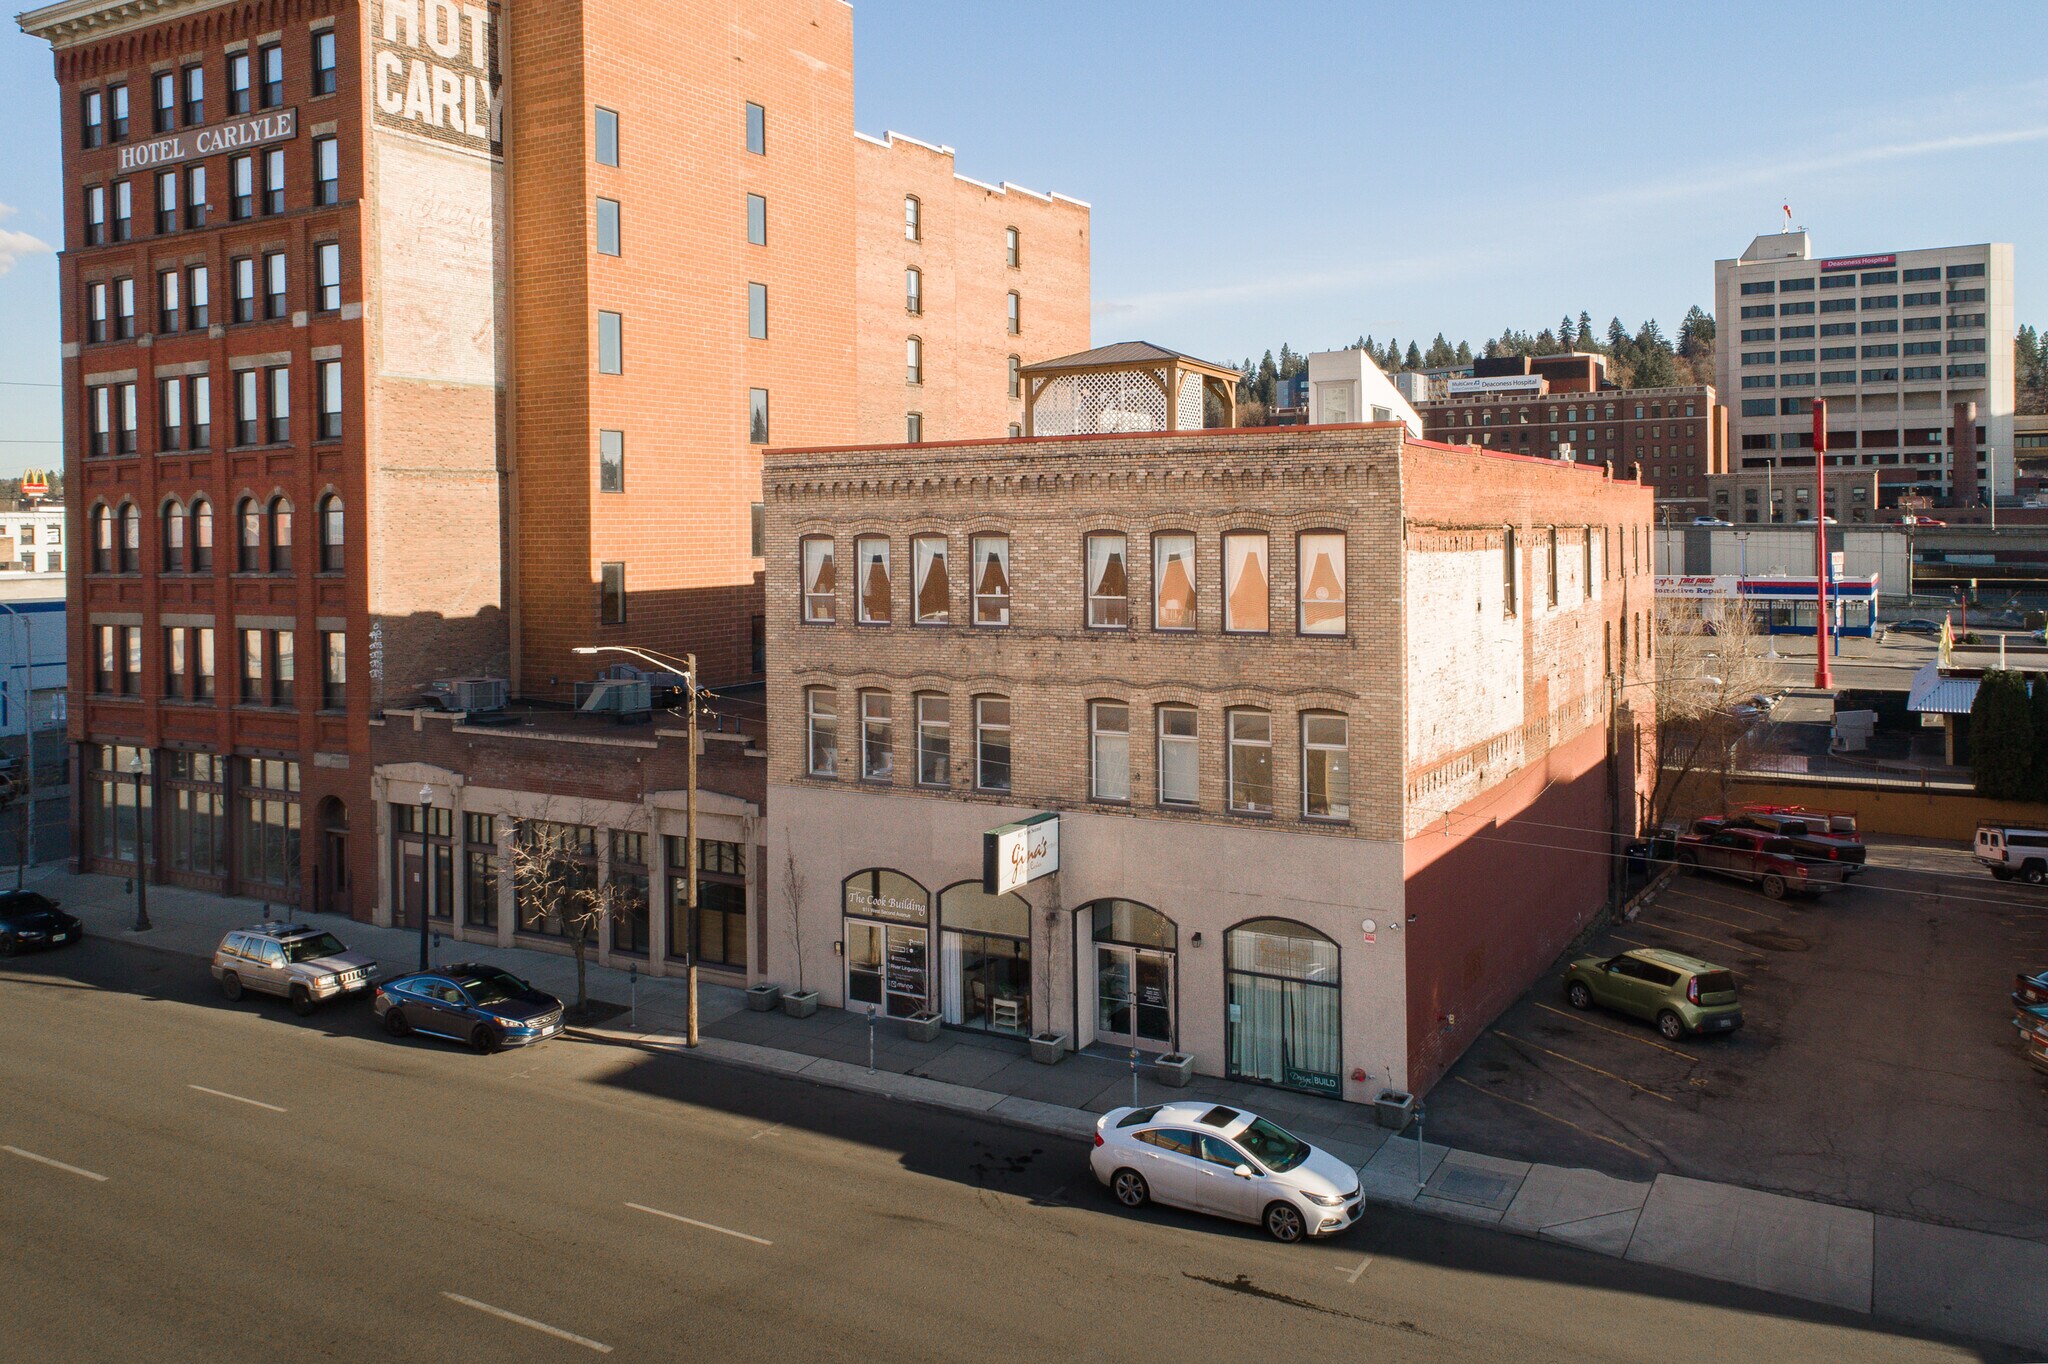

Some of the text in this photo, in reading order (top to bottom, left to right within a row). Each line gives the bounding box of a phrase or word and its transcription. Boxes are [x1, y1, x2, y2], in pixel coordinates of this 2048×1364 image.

[382, 0, 492, 69] HOT
[121, 113, 291, 169] HOTEL CARLYLE
[1828, 256, 1889, 267] Deaconess Hospital
[1513, 379, 1537, 388] Hospital
[1678, 577, 1695, 586] TIRE
[1694, 577, 1716, 586] PROS
[1696, 587, 1727, 595] Repair
[1011, 836, 1047, 884] Gina's
[848, 891, 926, 917] The Cook Building
[1313, 1076, 1336, 1087] BUILD
